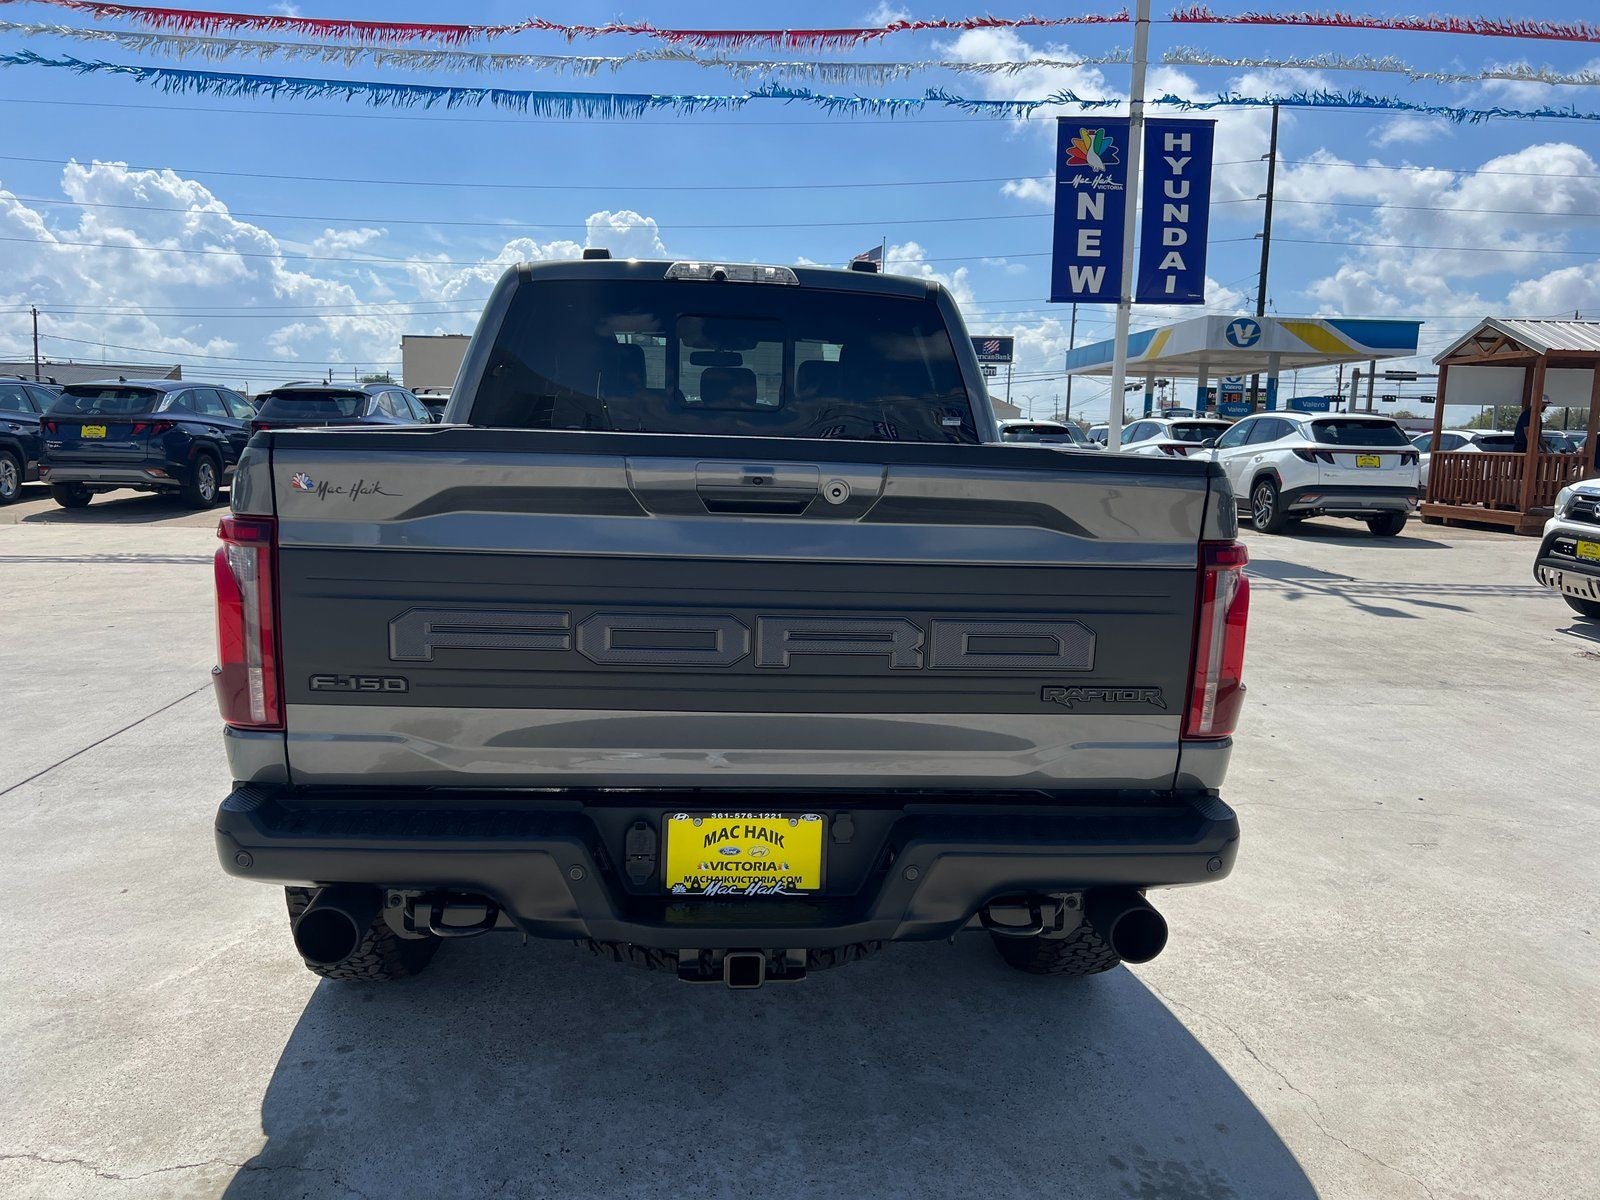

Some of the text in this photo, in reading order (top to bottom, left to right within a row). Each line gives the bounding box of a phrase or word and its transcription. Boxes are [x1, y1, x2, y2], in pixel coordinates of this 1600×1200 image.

[1069, 174, 1117, 189] Mac Haik
[1158, 133, 1192, 294] HYUNDAI
[1068, 192, 1107, 294] NEW
[314, 479, 391, 502] Mac Haik
[388, 606, 1097, 672] FORD
[309, 673, 409, 693] F-150
[1041, 685, 1167, 709] RAPTOR
[703, 825, 785, 849] MAC HAIK
[709, 861, 778, 871] VICTORIA
[703, 881, 786, 896] Mac Haik
